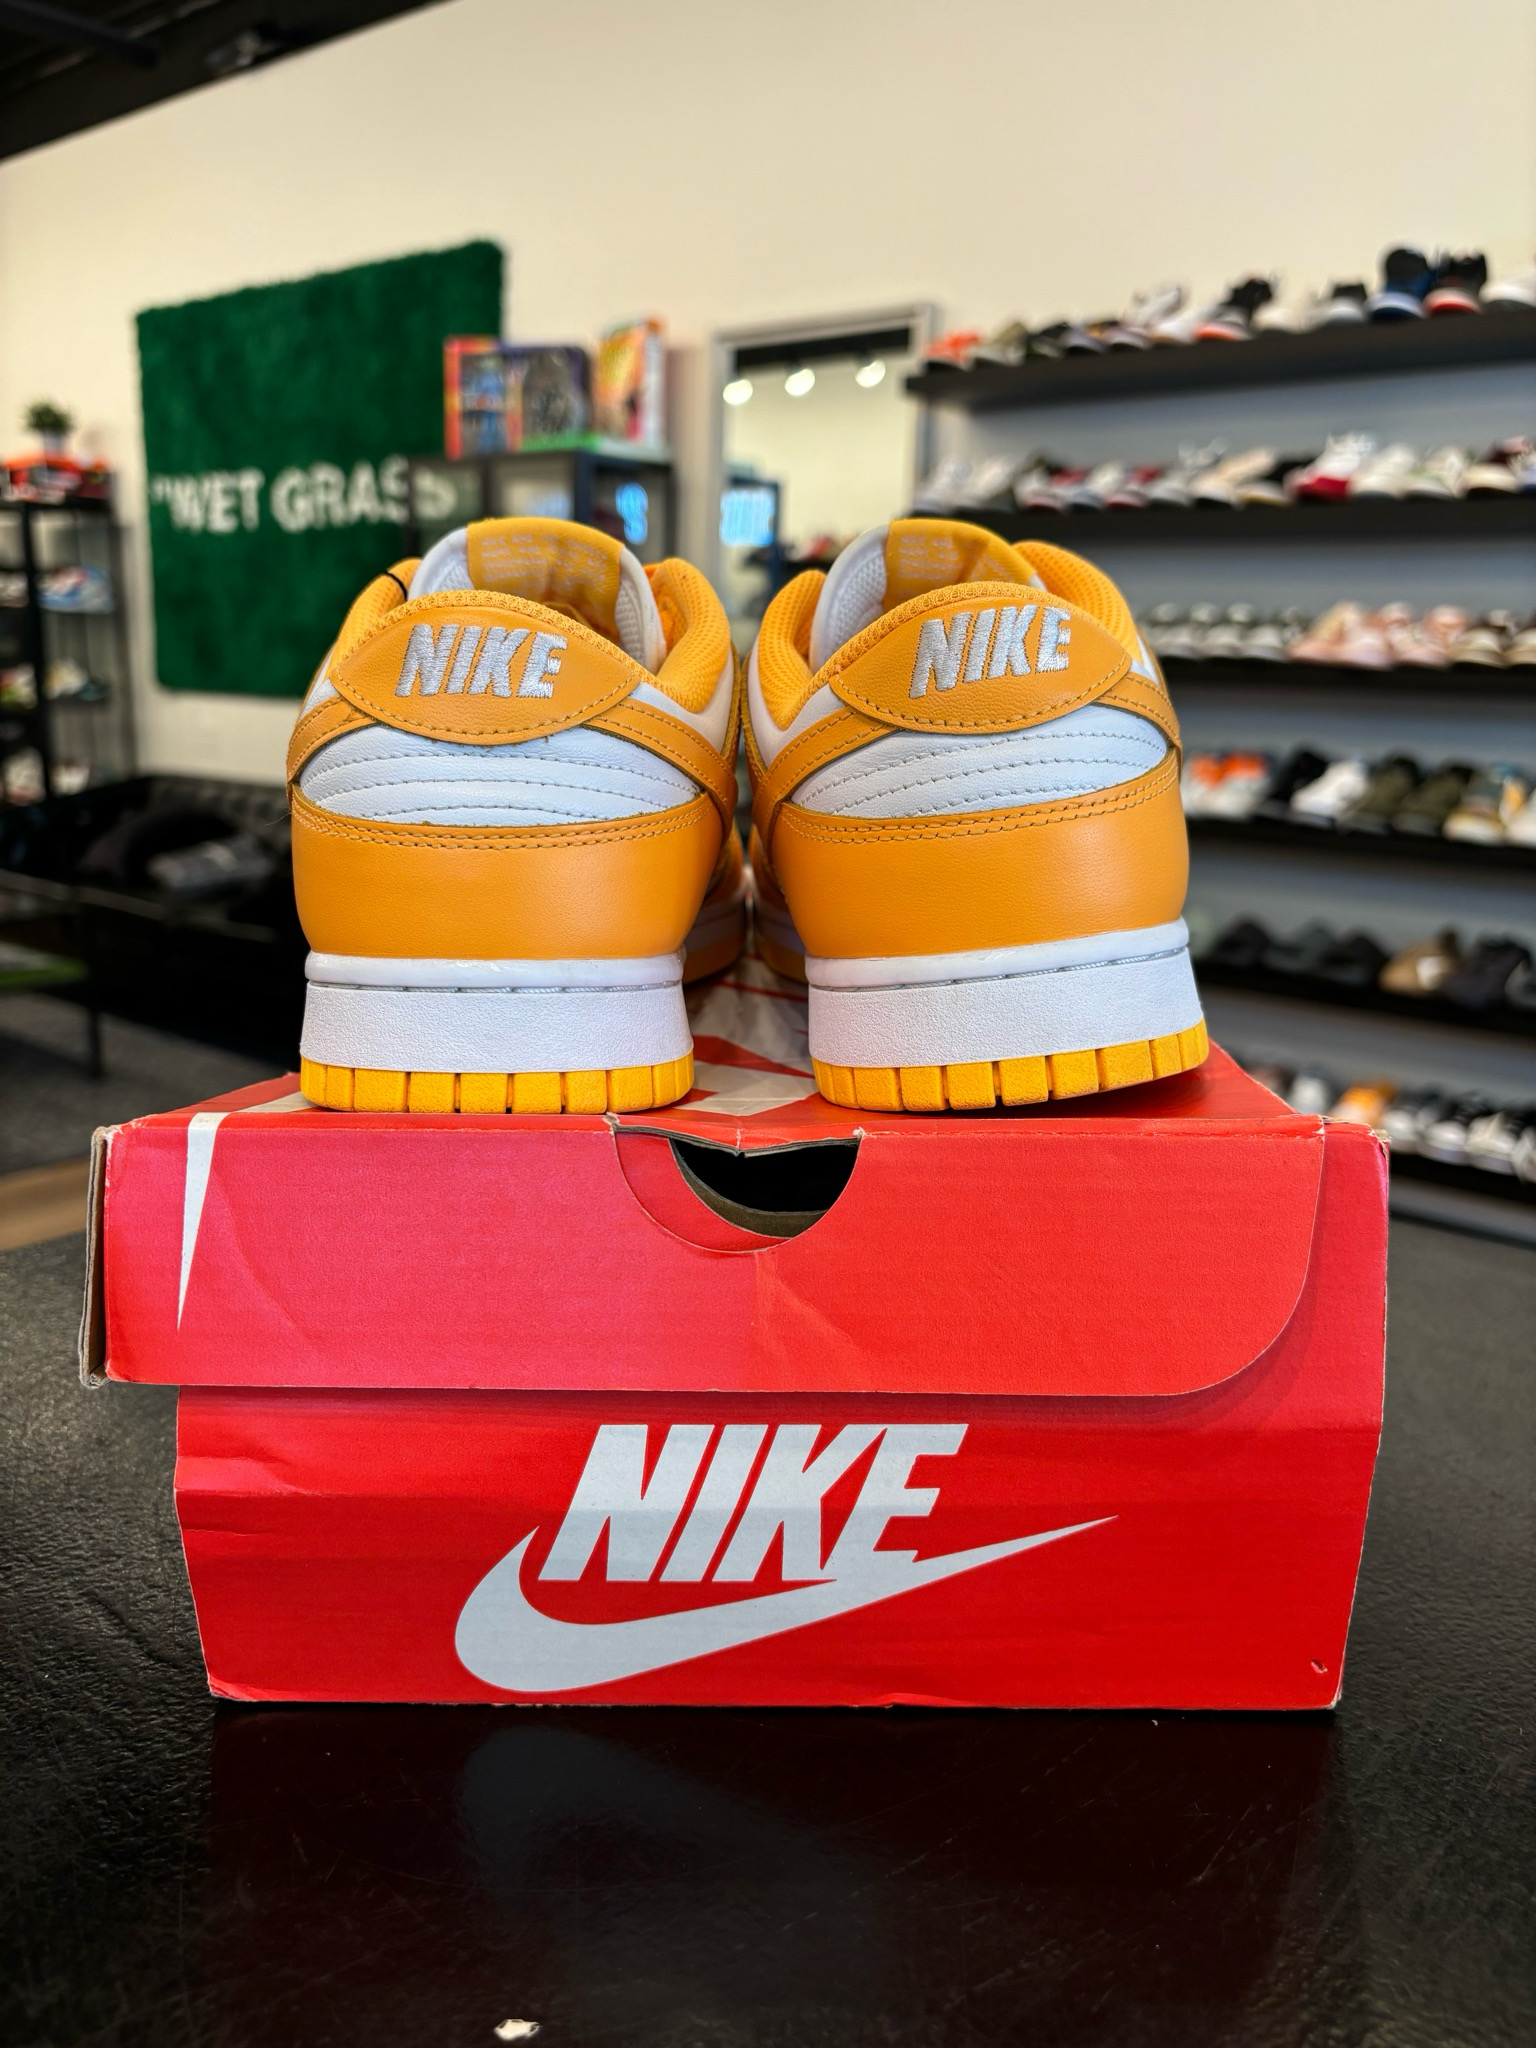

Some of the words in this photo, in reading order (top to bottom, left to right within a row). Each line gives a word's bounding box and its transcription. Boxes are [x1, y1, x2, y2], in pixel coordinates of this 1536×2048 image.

[394, 623, 568, 699] NIKE
[909, 604, 1071, 699] NIKE
[538, 1423, 969, 1583] NIKE
